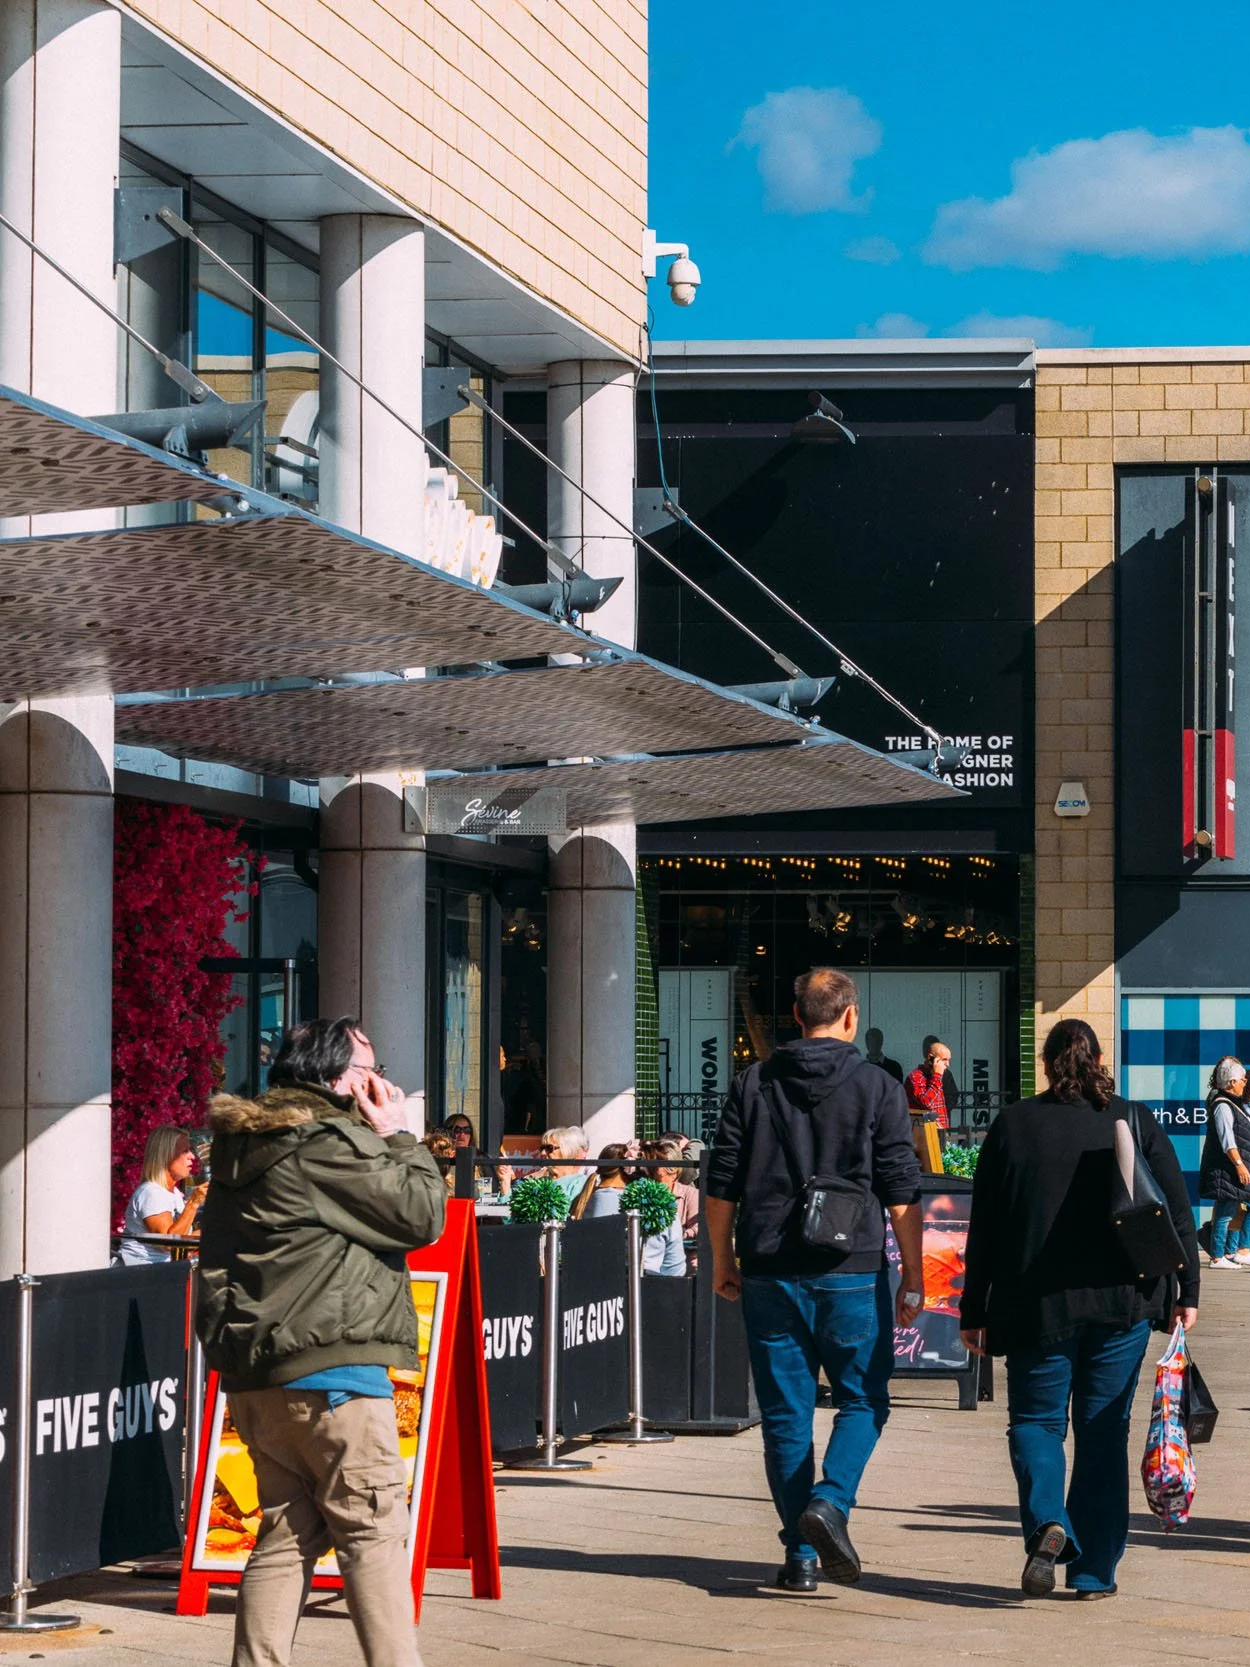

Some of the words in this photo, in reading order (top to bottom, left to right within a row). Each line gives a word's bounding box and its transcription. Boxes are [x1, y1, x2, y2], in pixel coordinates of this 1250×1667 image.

[1227, 501, 1235, 712] NEXT
[885, 736, 922, 750] THE
[987, 736, 1013, 749] OF
[962, 754, 1013, 768] GNER
[942, 773, 1013, 787] ASHION
[461, 798, 522, 826] Sévine
[1152, 1107, 1172, 1124] th
[1175, 1107, 1190, 1124] &
[563, 1306, 584, 1350] FIVE
[586, 1296, 624, 1343] GUYS
[482, 1315, 534, 1360] GUYS
[36, 1392, 100, 1455] FIVE
[107, 1377, 178, 1443] GUYS
